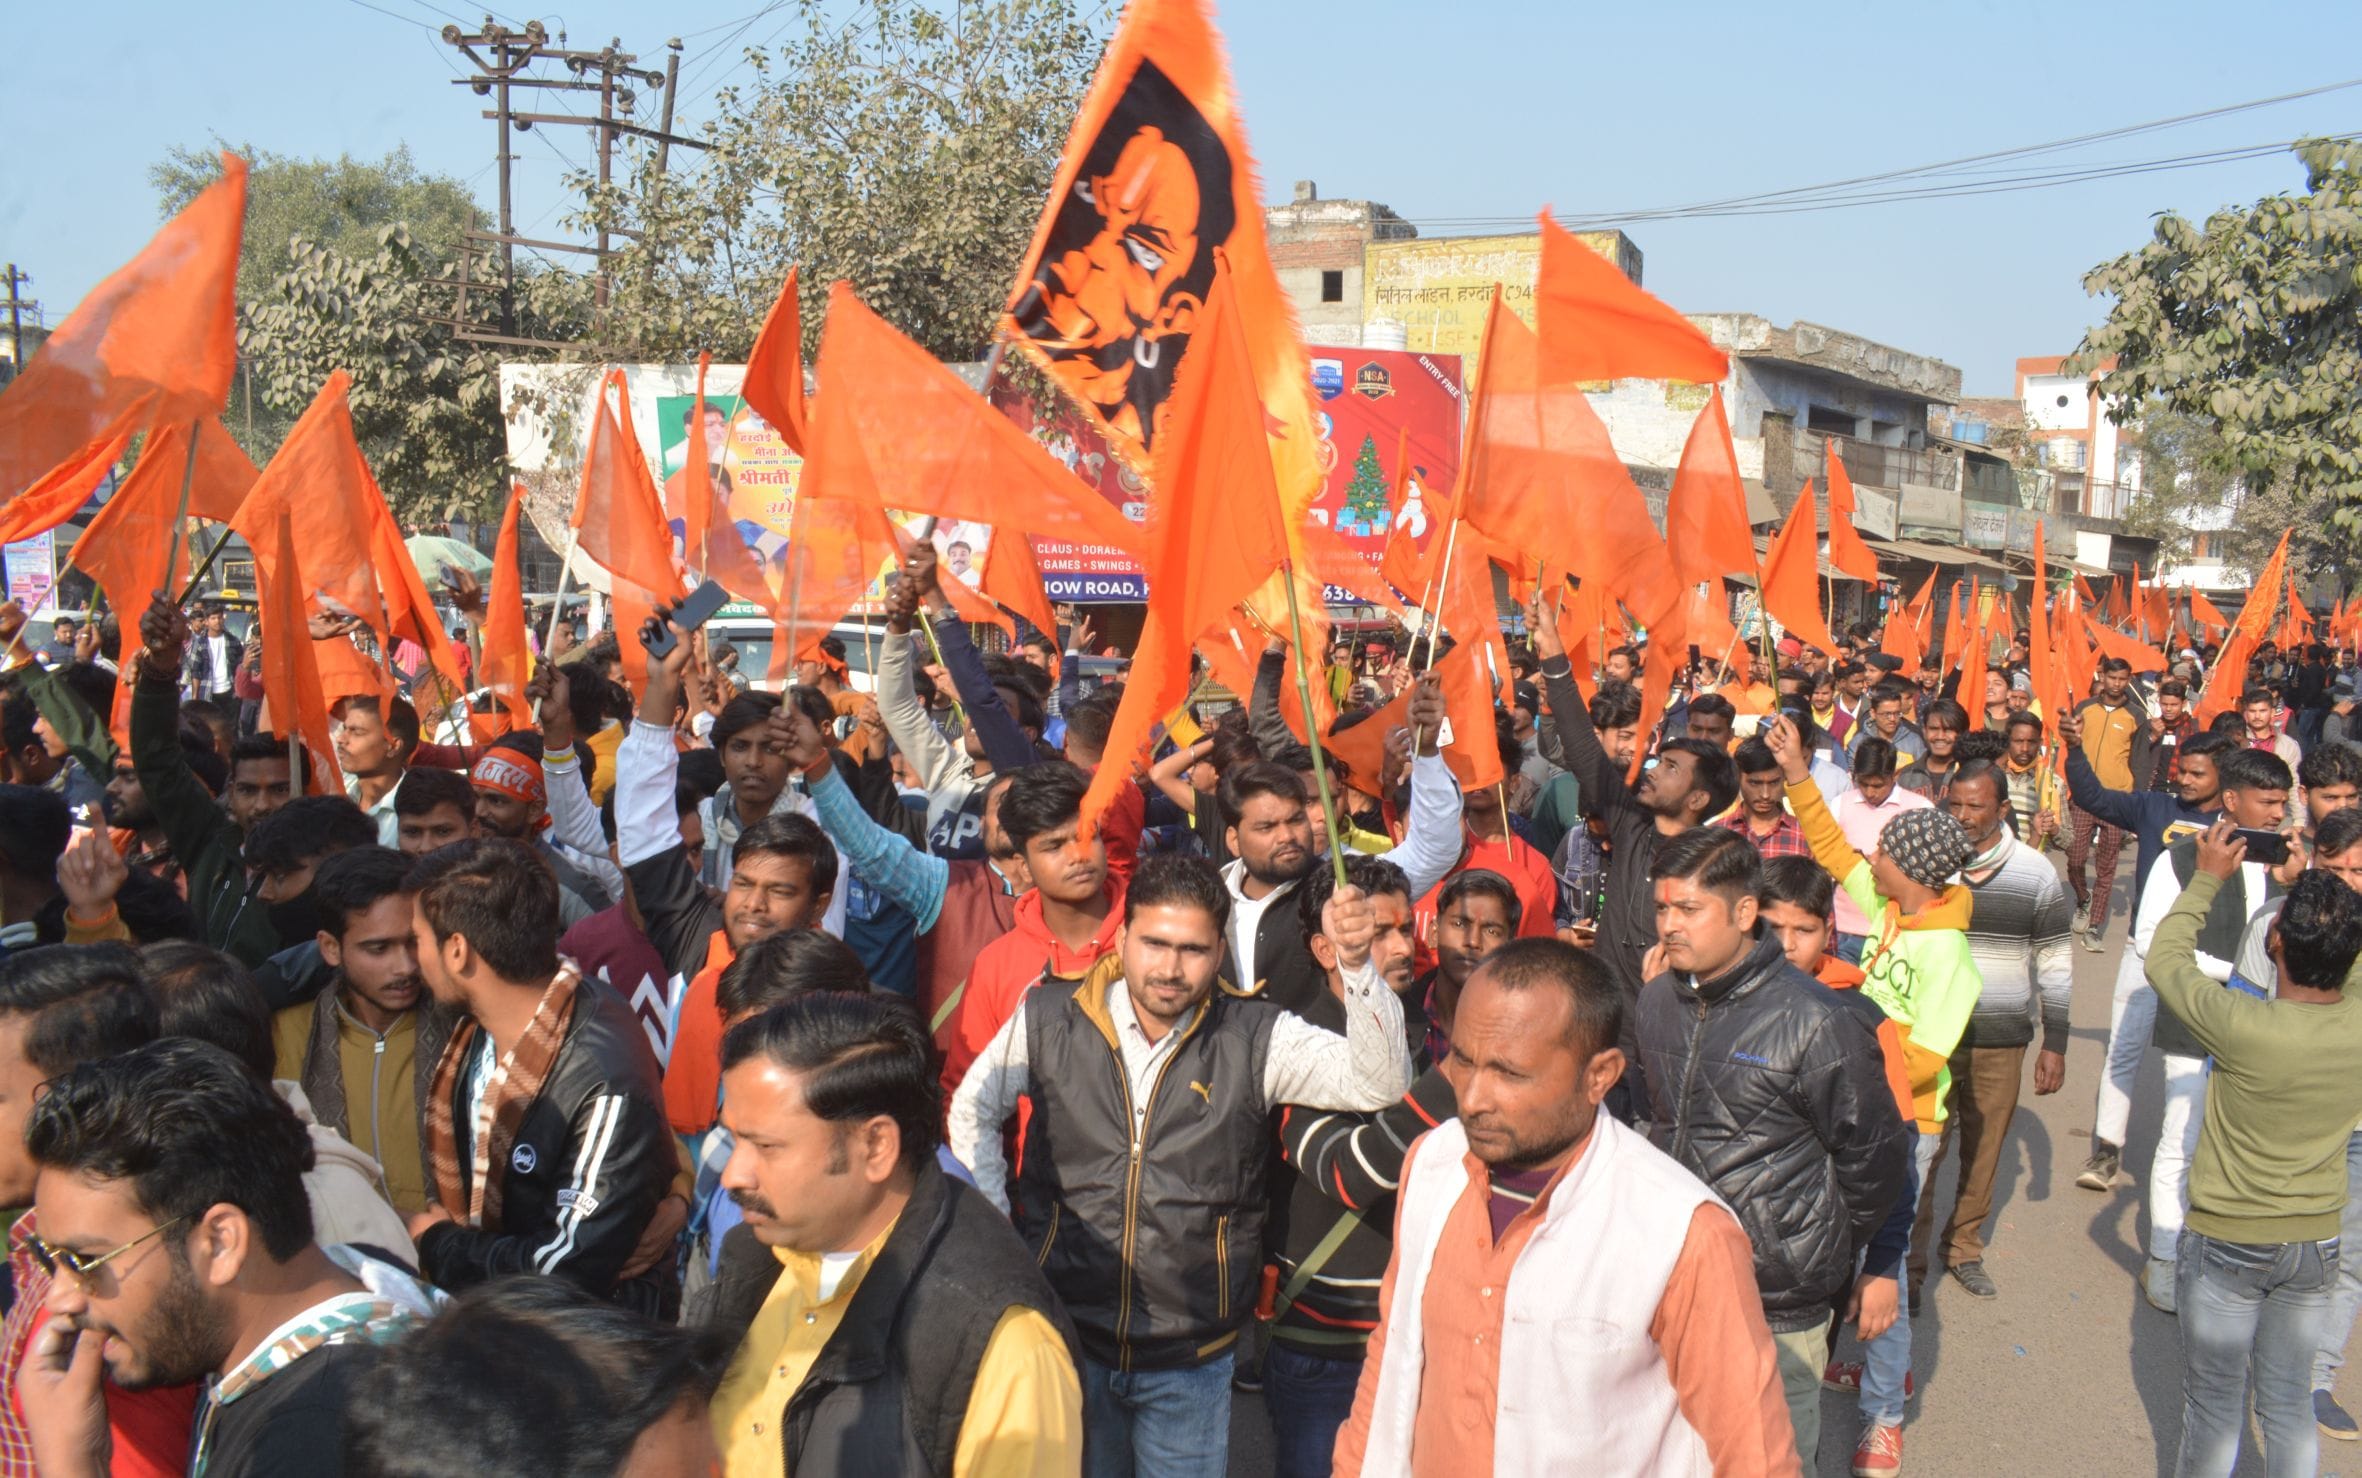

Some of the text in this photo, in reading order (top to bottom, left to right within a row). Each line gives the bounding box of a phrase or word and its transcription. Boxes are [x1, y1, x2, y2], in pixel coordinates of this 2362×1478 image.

[1364, 370, 1384, 382] NSA
[1419, 355, 1461, 398] ENTRY FREE
[1037, 543, 1073, 554] CLAUS
[1043, 560, 1132, 571] GAMES SWINGS
[1085, 582, 1138, 597] ROAD,
